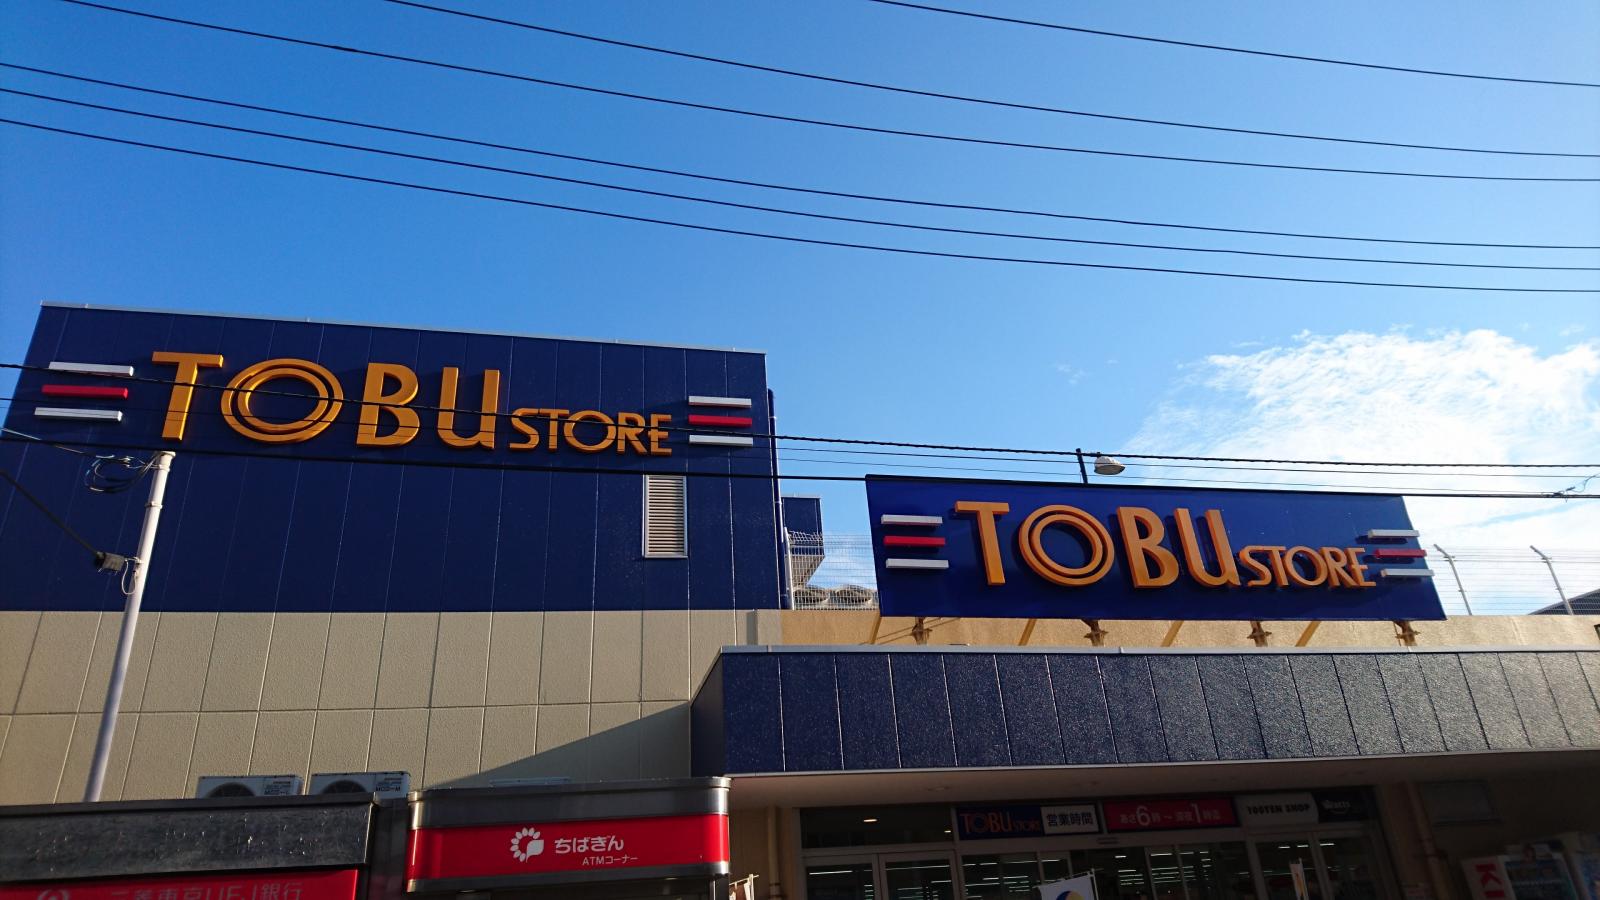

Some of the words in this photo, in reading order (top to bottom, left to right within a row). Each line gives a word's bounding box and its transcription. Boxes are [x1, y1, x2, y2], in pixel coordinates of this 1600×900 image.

[152, 351, 501, 450] TOBU
[508, 406, 674, 457] STORE
[954, 500, 1241, 589] TOBU
[1238, 545, 1377, 589] STORE
[959, 809, 1013, 833] TOBU
[1046, 812, 1094, 826] 営業時間
[554, 835, 624, 854] ちばぎん
[582, 854, 639, 866] ATMコーナー
